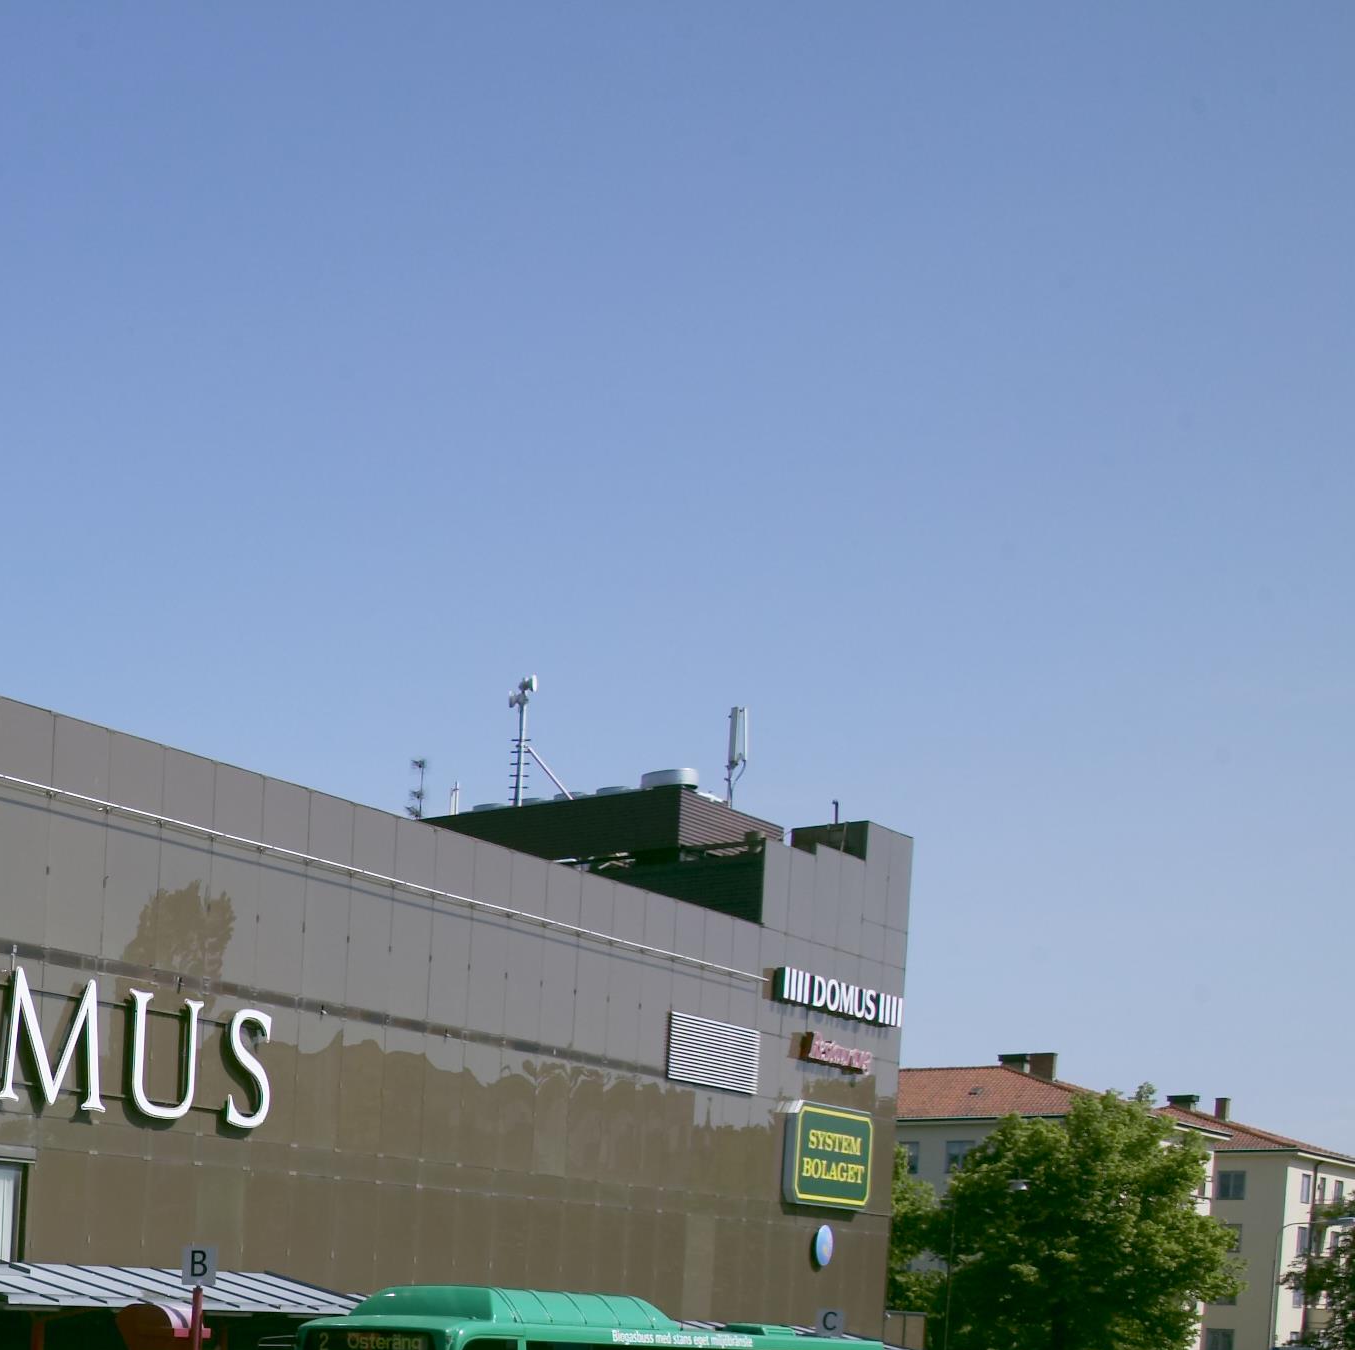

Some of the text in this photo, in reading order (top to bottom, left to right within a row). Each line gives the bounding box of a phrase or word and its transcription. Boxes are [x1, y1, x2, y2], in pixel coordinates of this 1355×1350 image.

[812, 974, 877, 1021] DOMUS
[808, 1129, 862, 1156] SYSTEM
[802, 1157, 865, 1184] BOLAGET
[191, 1249, 208, 1277] B
[822, 1311, 838, 1331] C
[655, 1332, 672, 1344] med
